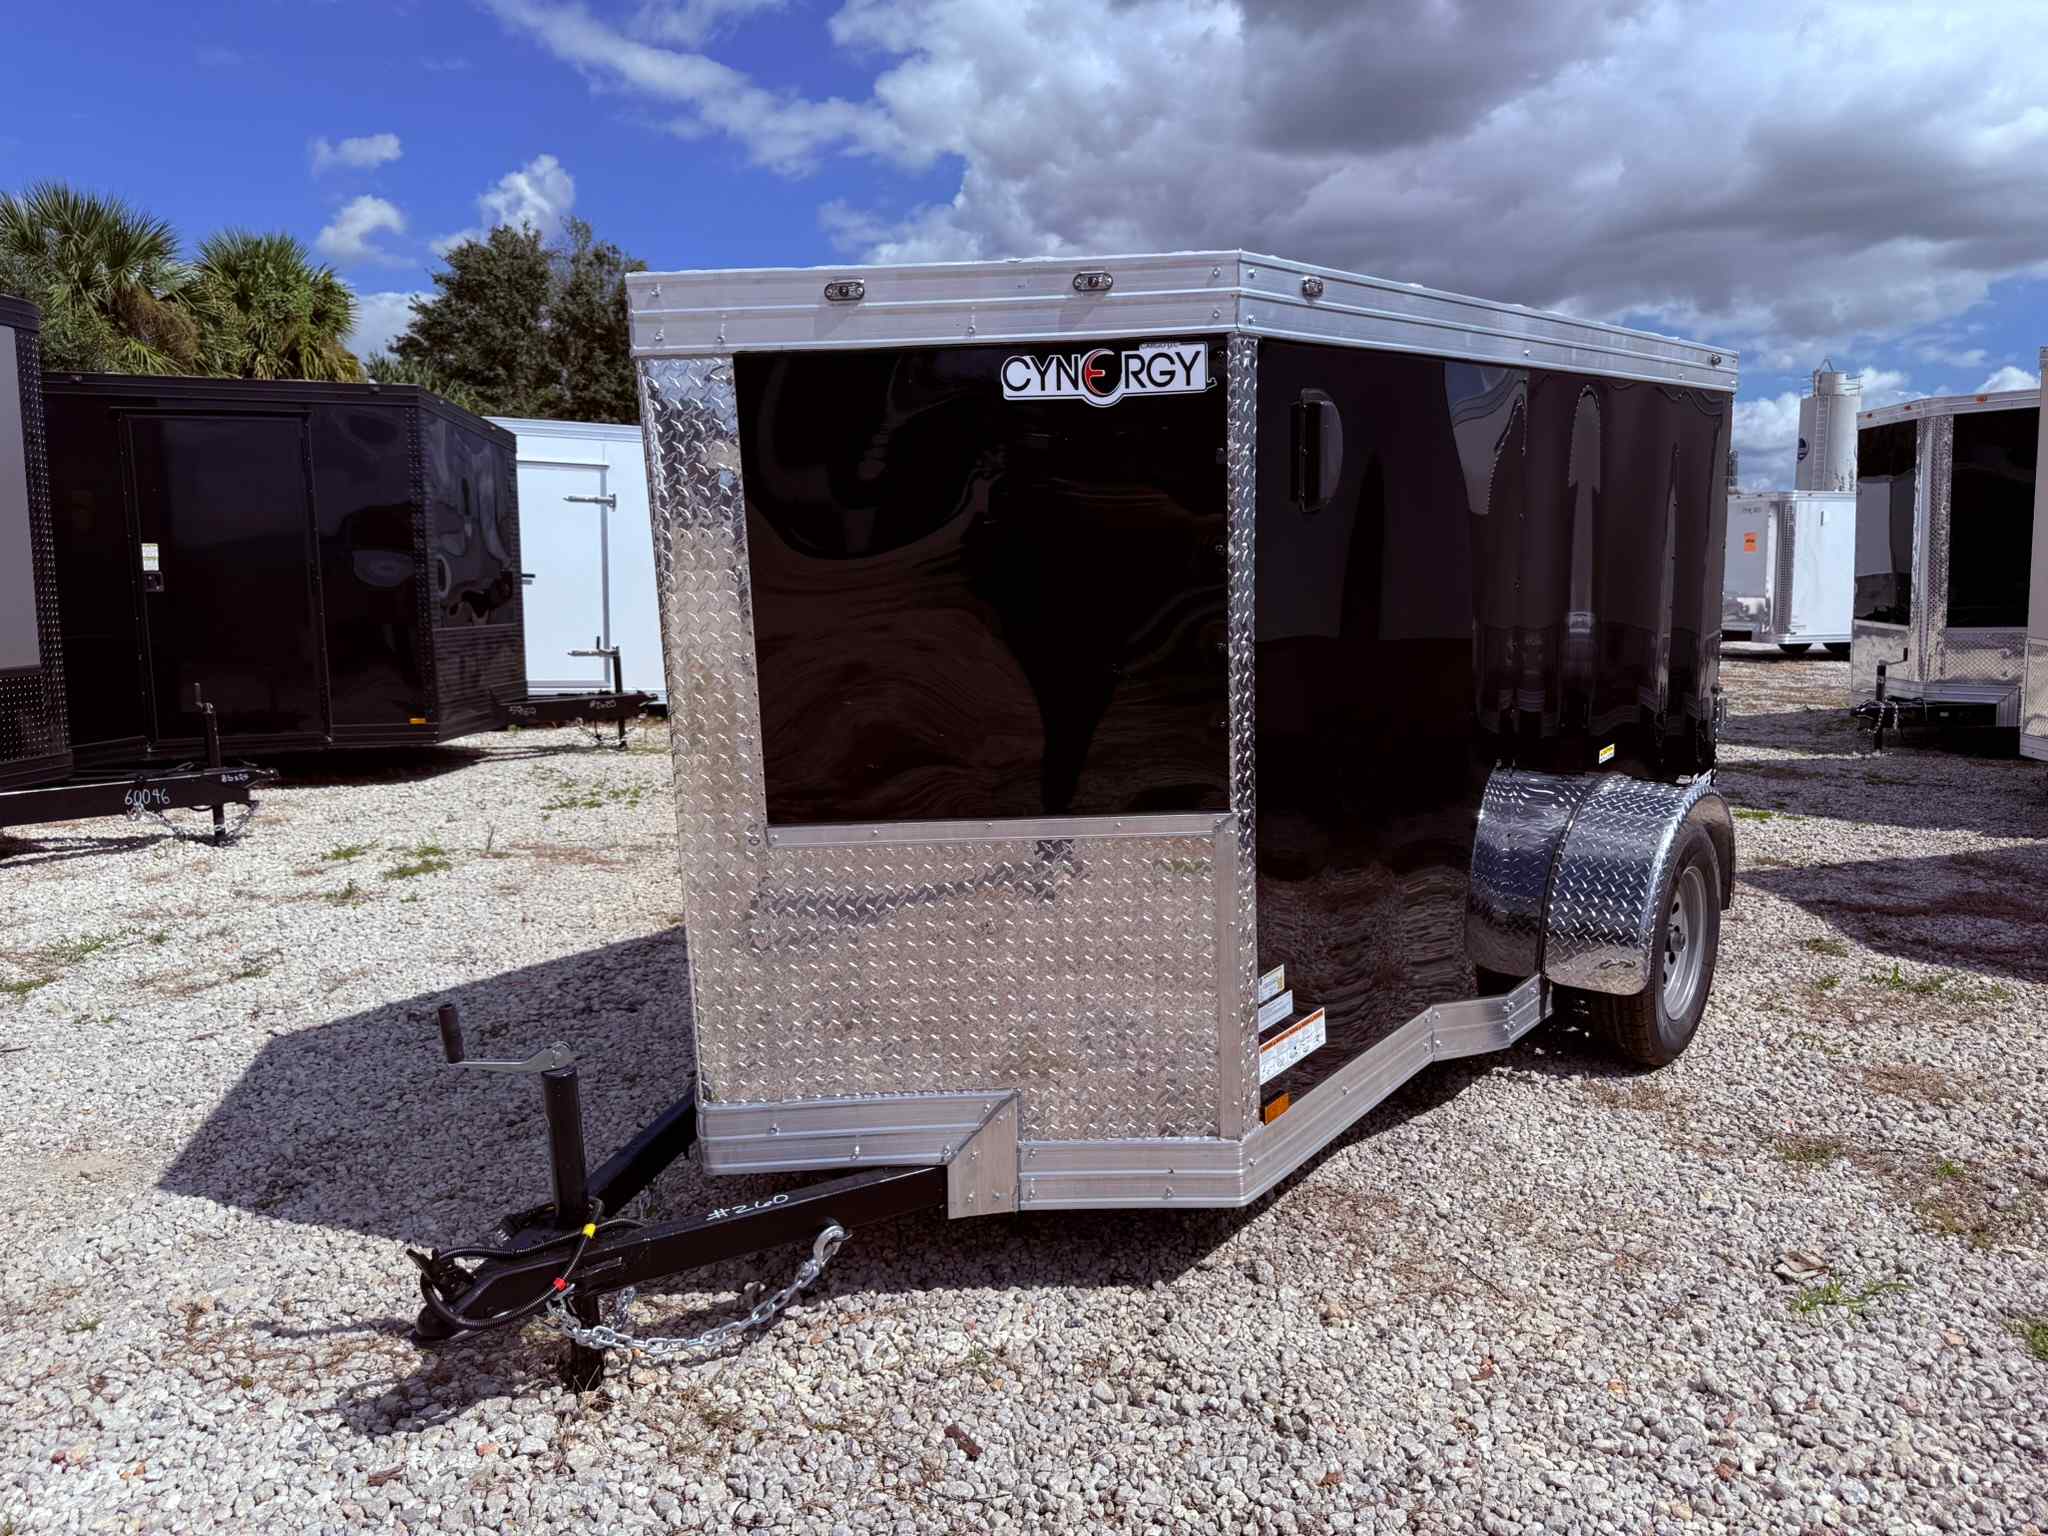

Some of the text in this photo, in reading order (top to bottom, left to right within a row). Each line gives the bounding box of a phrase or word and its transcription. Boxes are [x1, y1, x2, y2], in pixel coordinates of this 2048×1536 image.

[1002, 349, 1201, 397] CYNERGY
[124, 788, 171, 805] 60046
[706, 1194, 789, 1221] #260
